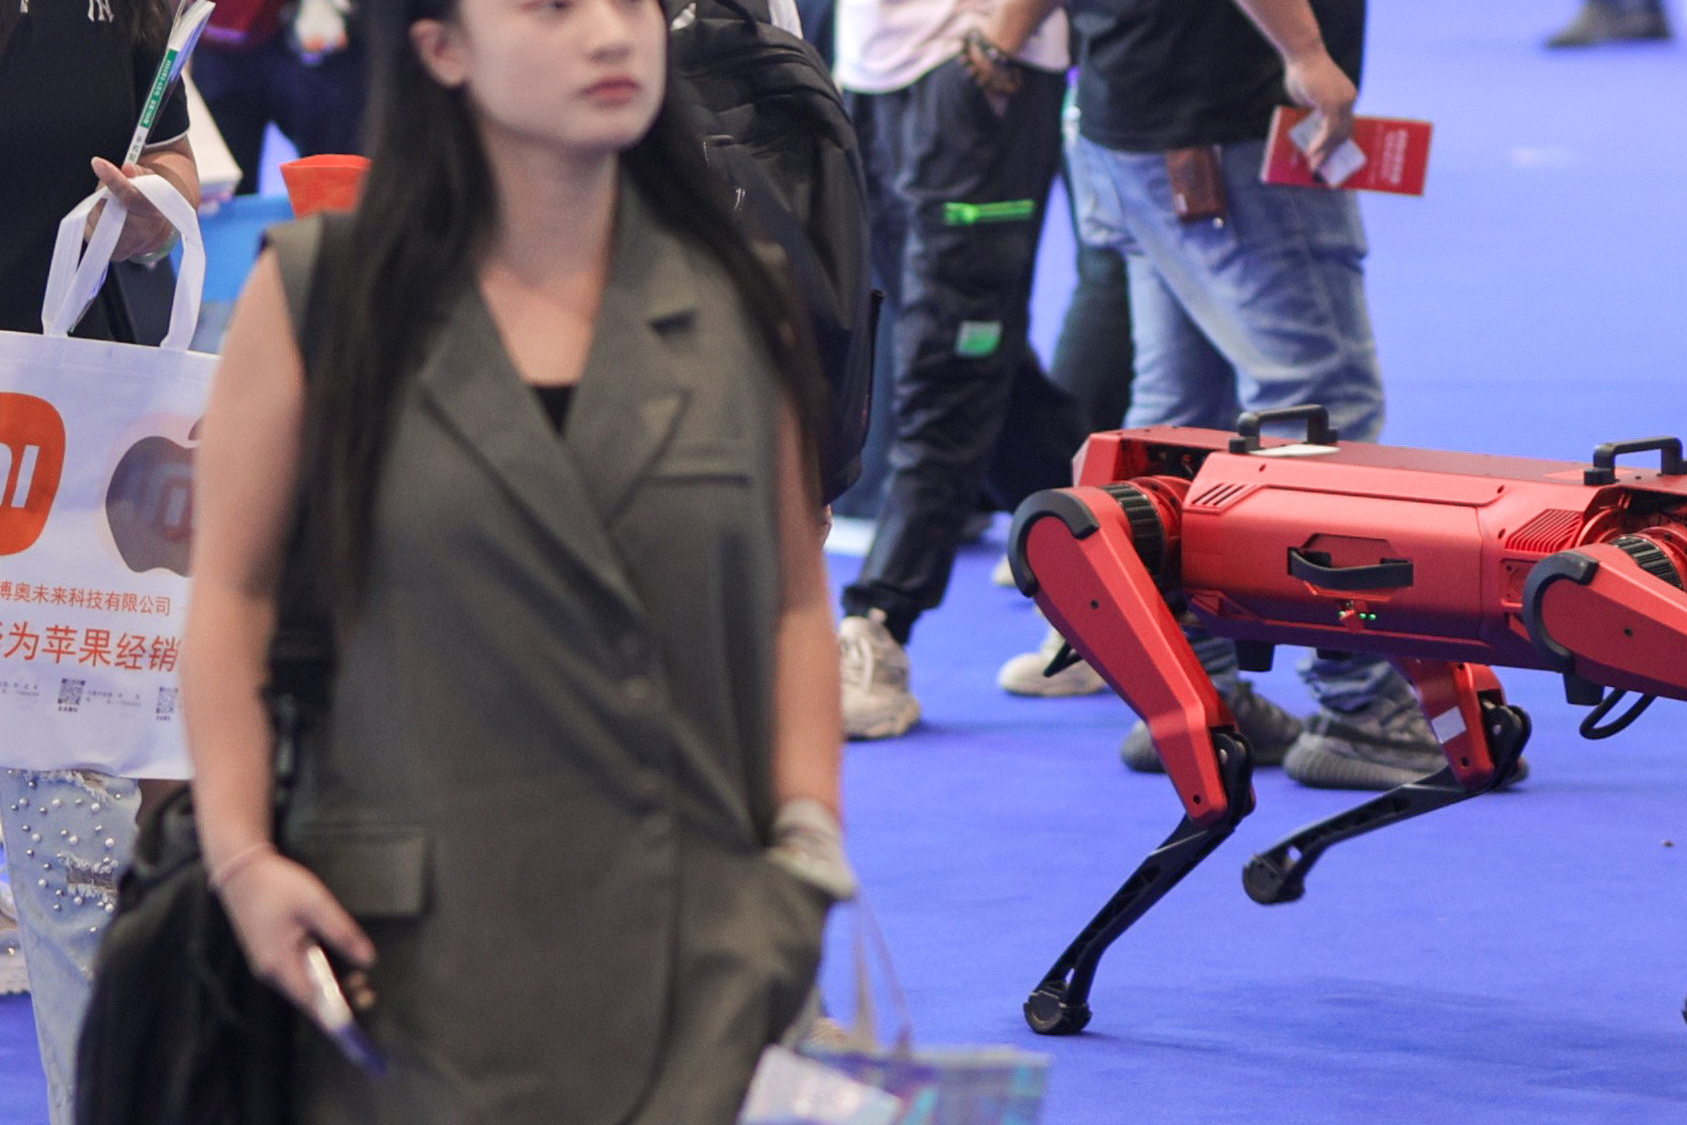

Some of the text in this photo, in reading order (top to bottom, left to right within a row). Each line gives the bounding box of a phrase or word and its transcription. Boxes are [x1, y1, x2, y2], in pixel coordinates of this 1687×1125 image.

[0, 621, 181, 673] 为苹果经销
